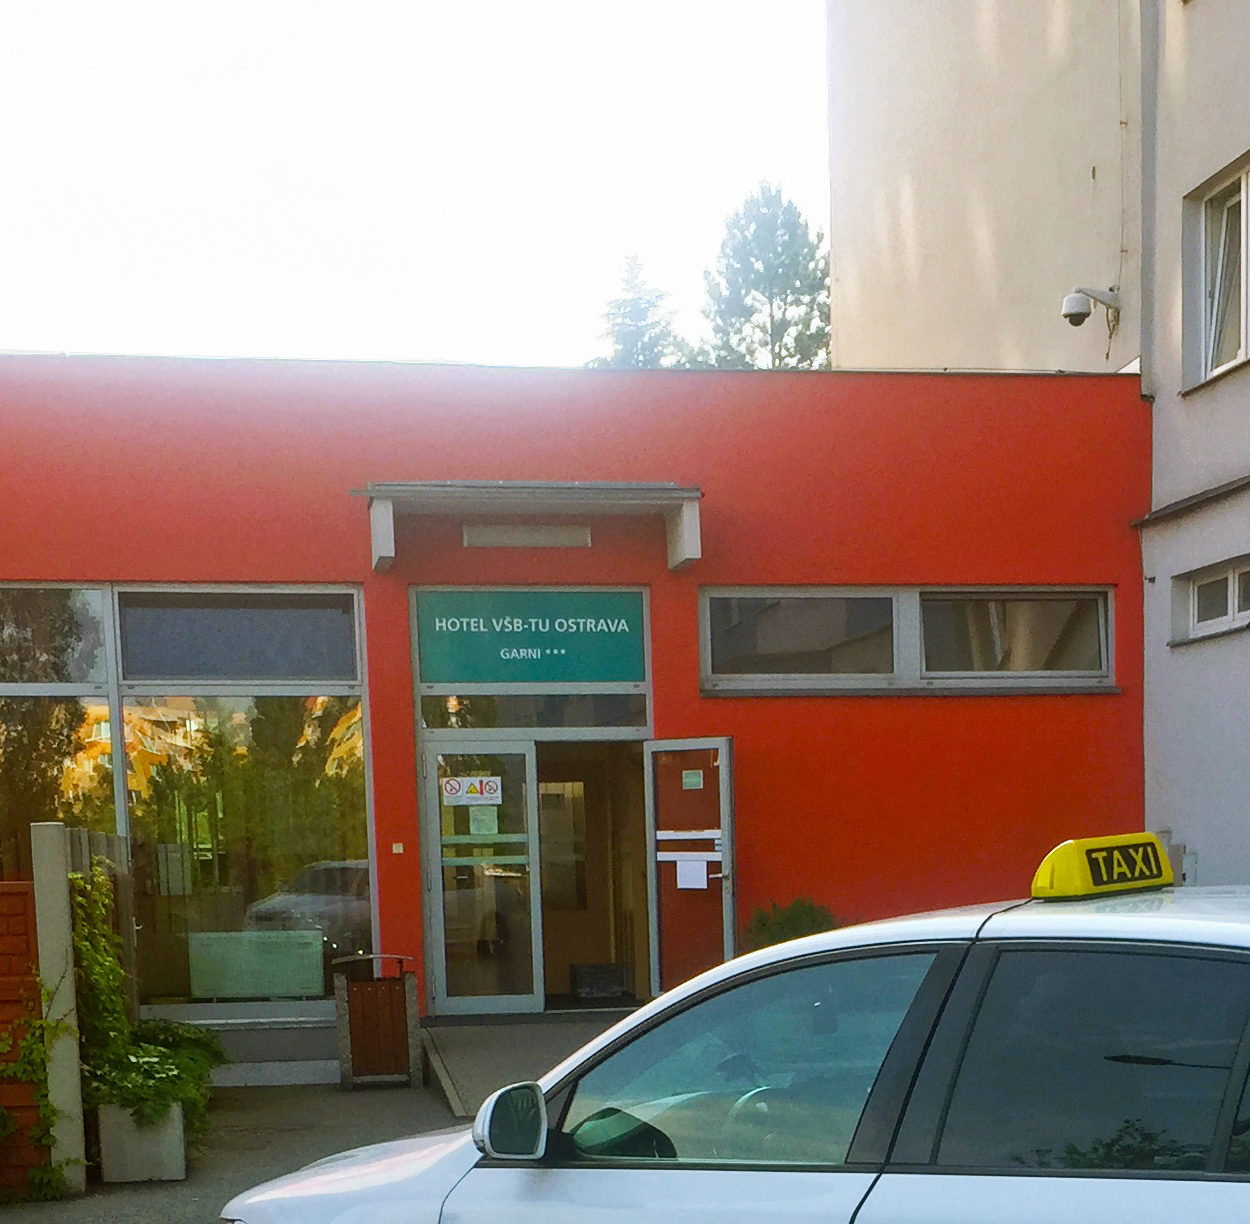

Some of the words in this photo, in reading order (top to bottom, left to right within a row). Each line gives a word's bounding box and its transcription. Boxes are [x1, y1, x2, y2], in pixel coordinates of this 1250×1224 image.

[435, 618, 488, 632] HOTEL
[491, 616, 550, 632] VŠB-TU
[554, 618, 629, 633] OSTRAVA
[500, 648, 541, 660] GARNI
[1091, 846, 1157, 881] TAXI
